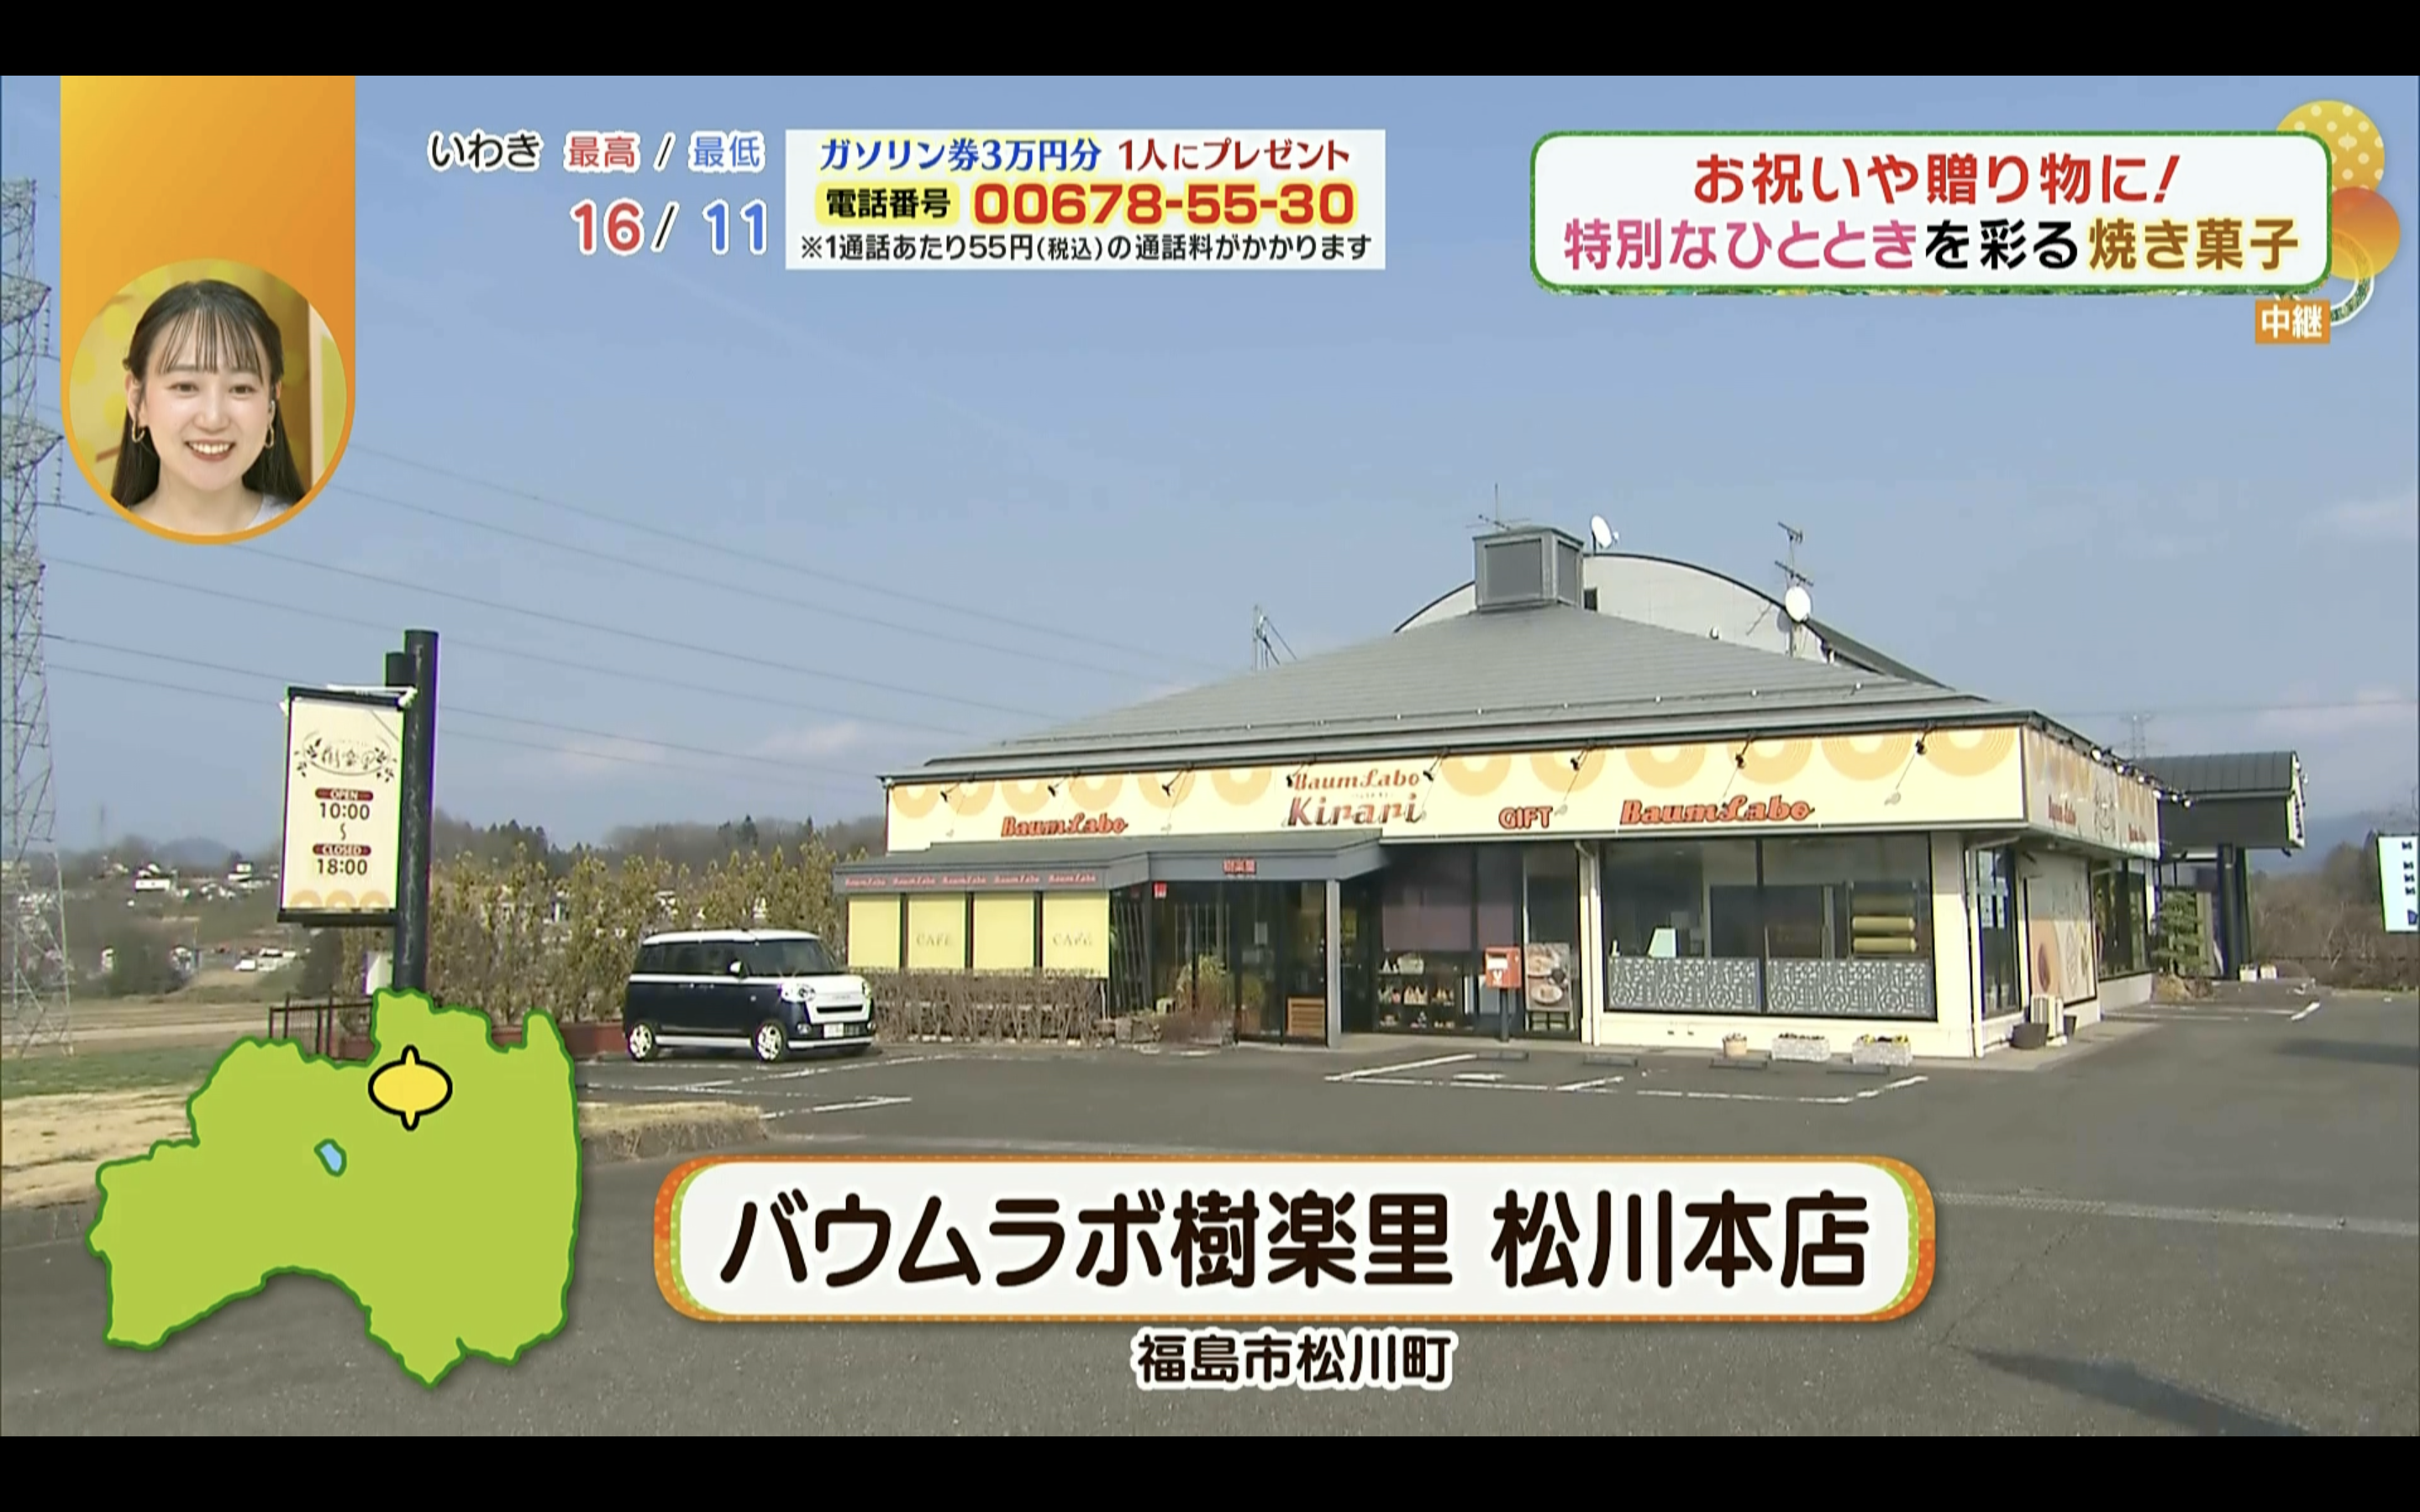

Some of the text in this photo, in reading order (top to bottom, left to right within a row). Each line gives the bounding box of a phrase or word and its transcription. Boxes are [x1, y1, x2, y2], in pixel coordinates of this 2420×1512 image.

[330, 788, 359, 801] OPEN
[320, 801, 371, 821] 10:00
[1286, 792, 1426, 827] Kirari
[1498, 806, 1554, 830] GIFT
[322, 843, 363, 856] CLOSED
[318, 858, 368, 875] 18:00
